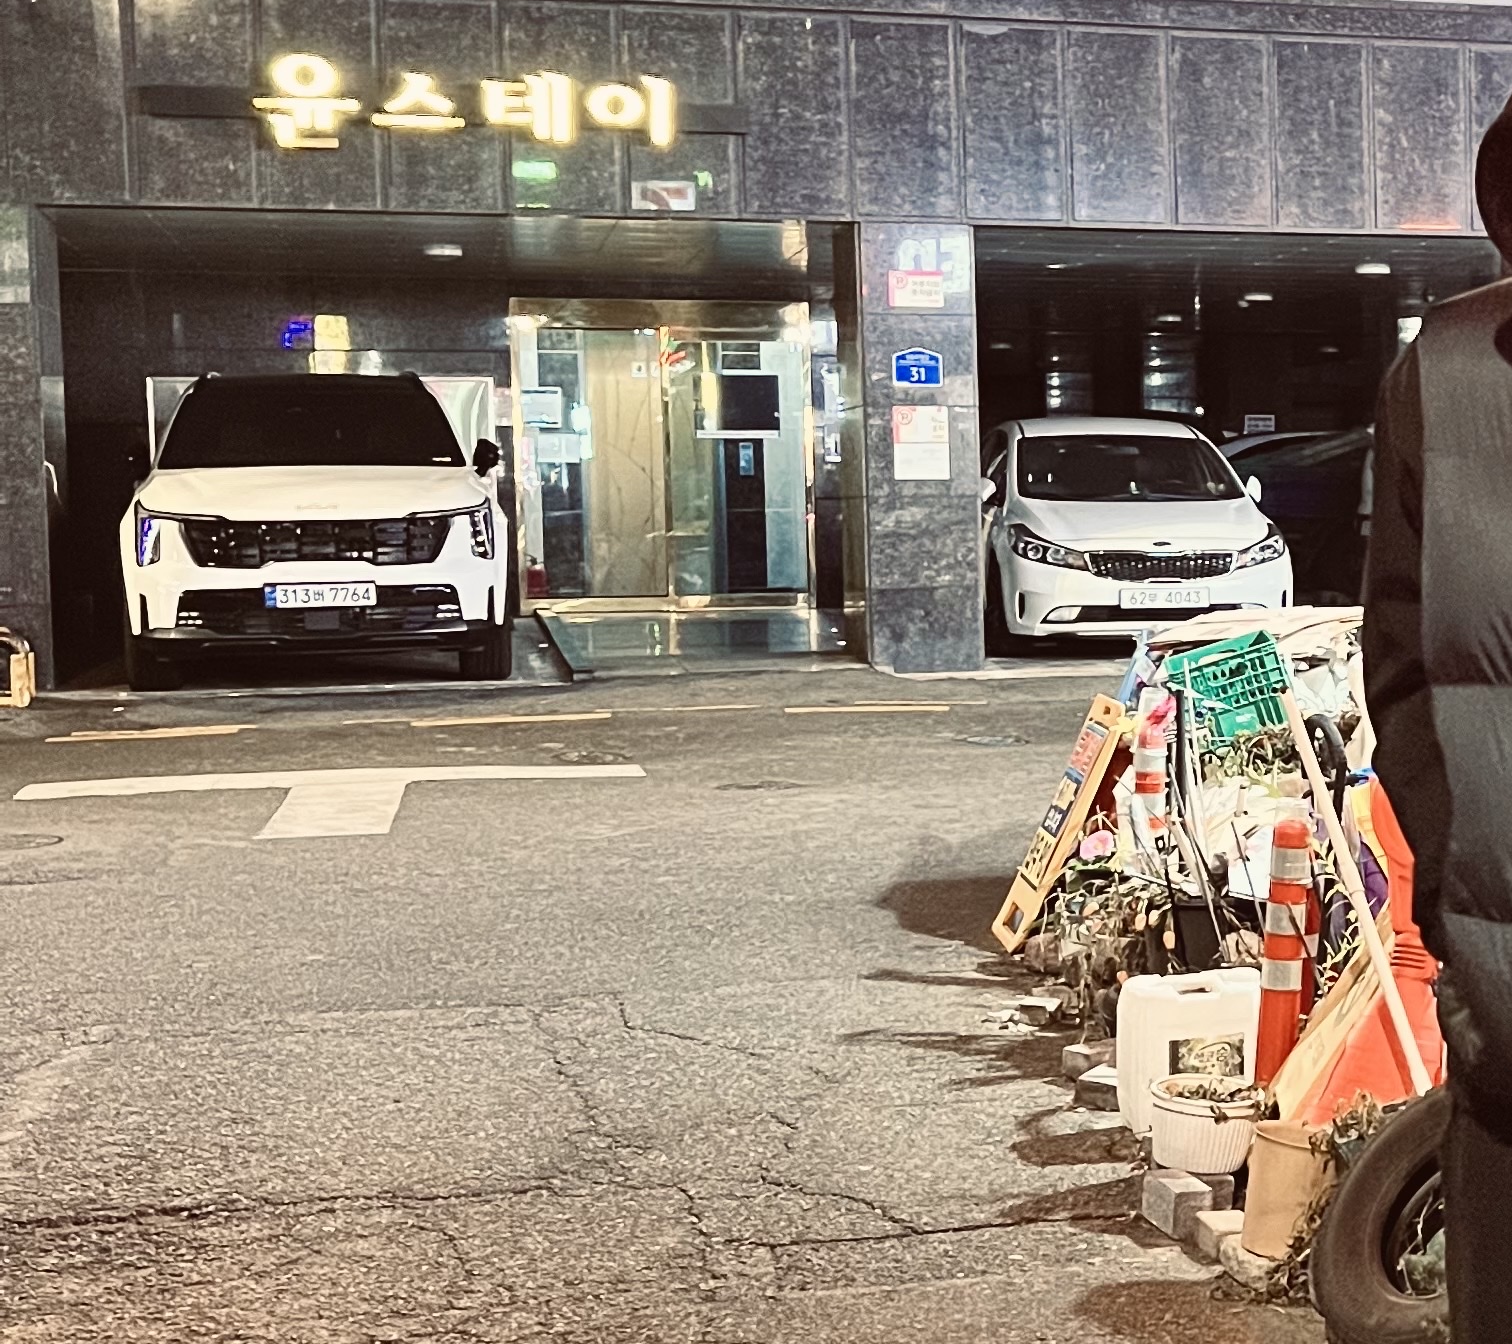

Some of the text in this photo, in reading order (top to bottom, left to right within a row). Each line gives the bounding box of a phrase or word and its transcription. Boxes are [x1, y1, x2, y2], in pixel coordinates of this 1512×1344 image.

[252, 50, 678, 150] 윤스테이
[909, 367, 926, 382] 31
[329, 587, 371, 603] 7764
[1164, 590, 1201, 605] 4043
